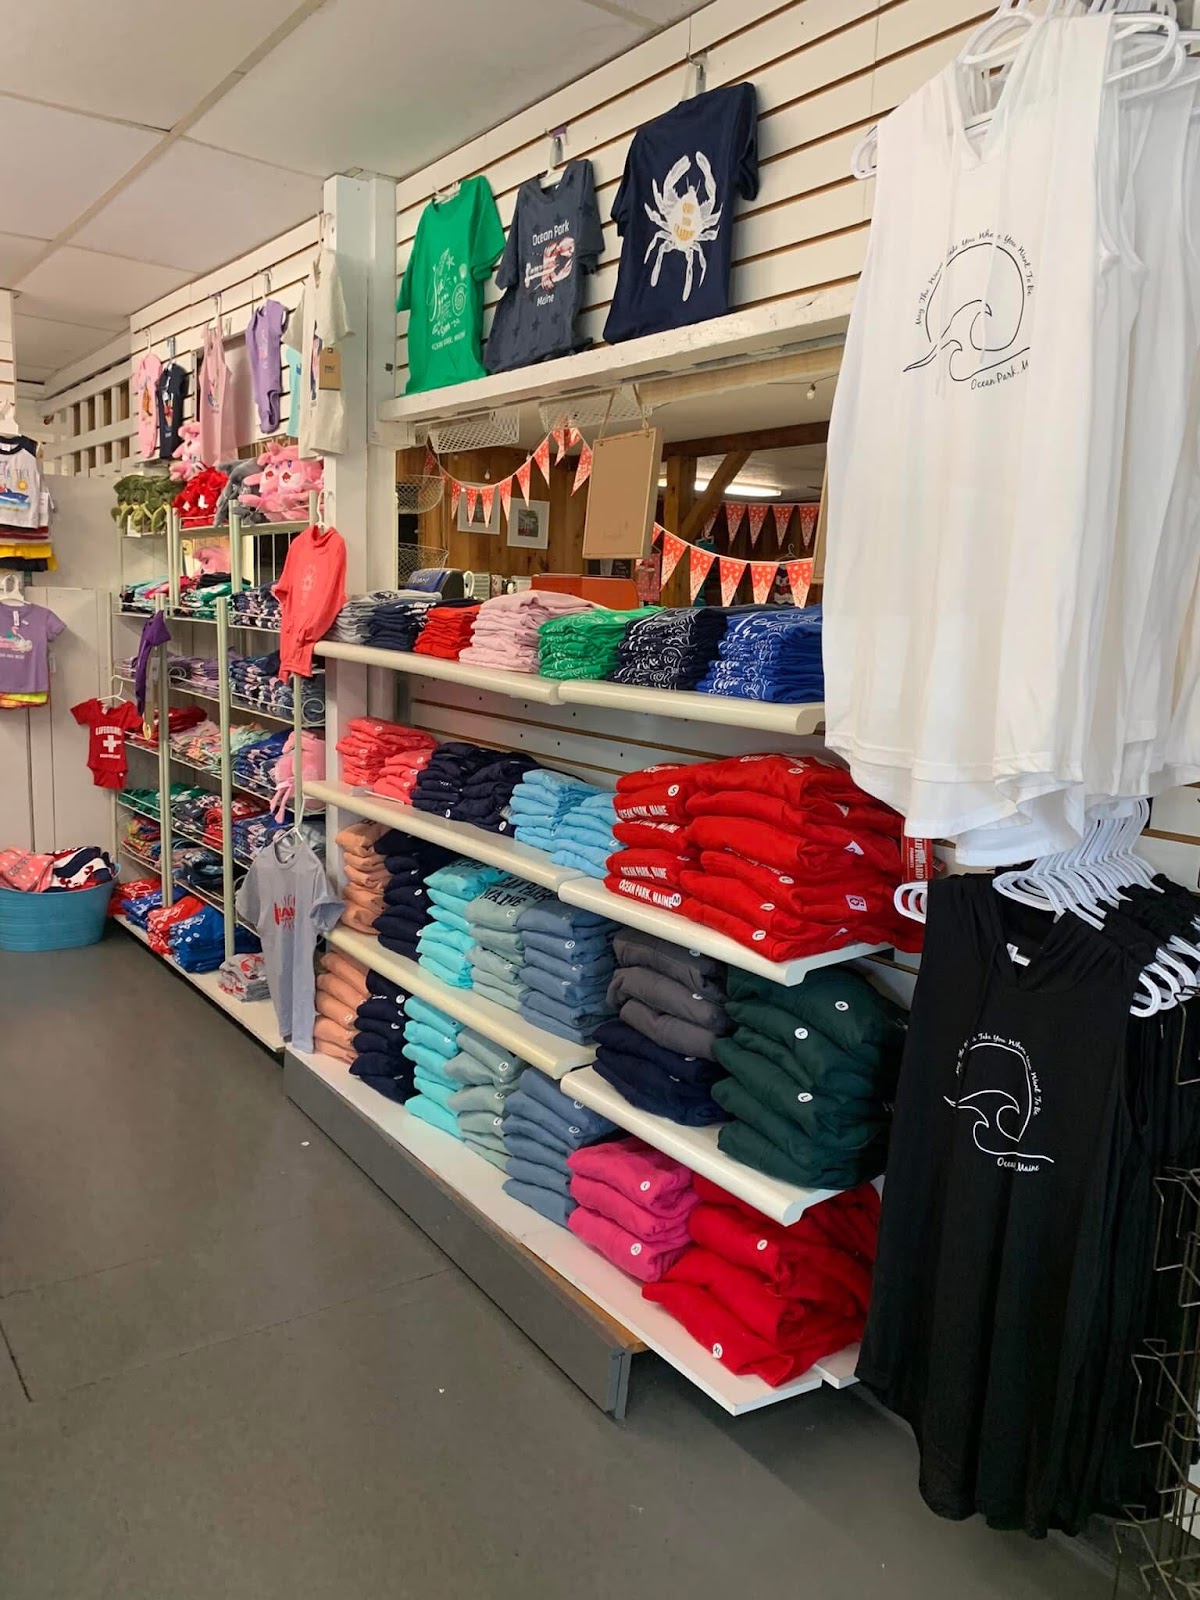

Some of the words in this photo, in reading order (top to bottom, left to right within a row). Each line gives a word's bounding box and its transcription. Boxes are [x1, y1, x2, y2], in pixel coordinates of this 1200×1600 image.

[532, 229, 554, 246] Ocean
[553, 219, 570, 238] Park
[1003, 234, 1017, 248] You
[1026, 270, 1034, 283] To
[1026, 285, 1035, 297] Be
[536, 293, 555, 307] Maine
[970, 378, 997, 391] Ocean
[619, 879, 636, 896] OCEAN
[652, 892, 674, 909] MAINE
